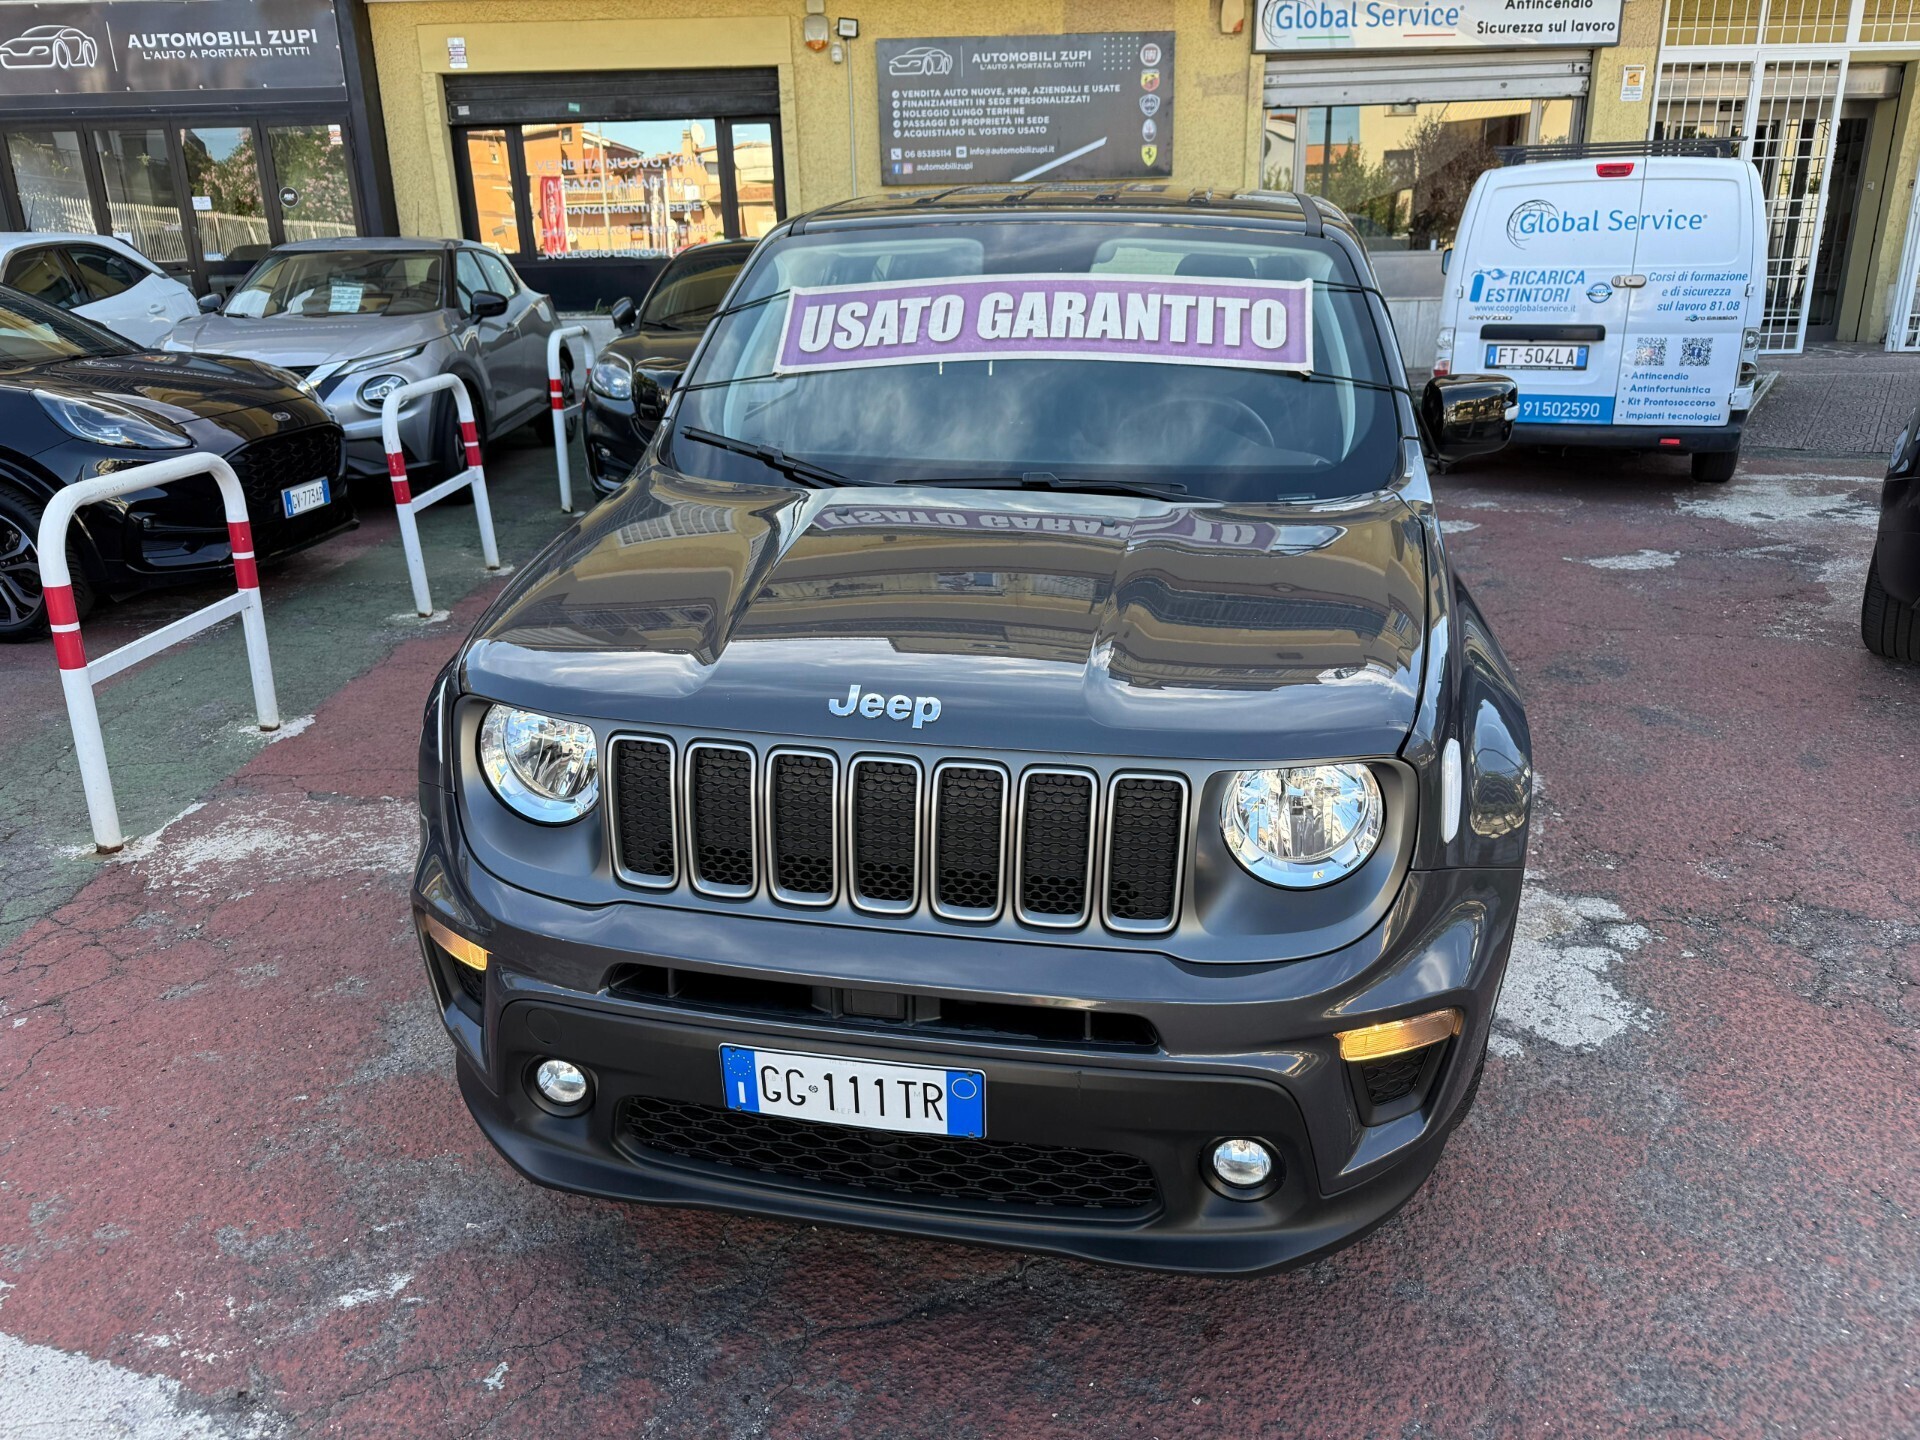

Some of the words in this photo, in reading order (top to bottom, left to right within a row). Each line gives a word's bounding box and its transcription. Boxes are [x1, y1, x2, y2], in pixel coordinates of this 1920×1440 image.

[1276, 1, 1358, 29] Global
[1366, 2, 1459, 27] Service
[1477, 21, 1543, 34] Sicurezza
[1548, 20, 1566, 32] sul
[1571, 20, 1615, 32] lavoro
[128, 31, 261, 48] AUTOMOBILI
[268, 29, 318, 44] ZUPI
[143, 50, 186, 59] L'AUTO
[202, 48, 257, 58] PORTATA
[261, 48, 272, 56] DI
[276, 47, 310, 56] TUTTI
[972, 52, 1056, 63] AUTOMOBILI
[1060, 50, 1092, 60] ZUPI
[902, 90, 940, 98] VENDITA
[944, 88, 968, 96] AUTO
[971, 88, 1004, 96] NUOVE,
[1033, 85, 1081, 94] AZIENDALI
[1084, 85, 1089, 93] E
[1092, 84, 1120, 92] USATE
[902, 99, 973, 108] FINANZIAMENTI
[976, 98, 985, 106] IN
[1014, 95, 1090, 104] PERSONALIZZATI
[902, 109, 949, 118] NOLEGGIO
[952, 108, 983, 116] LUNGO
[986, 107, 1025, 115] TERMINE
[903, 119, 946, 127] PASSAGGI
[950, 118, 959, 126] DI
[962, 116, 1012, 126] PROPRIETÀ
[1027, 116, 1049, 124] SEDE
[904, 129, 965, 138] ACQUISTIAMO
[979, 127, 1015, 135] VOSTRO
[1018, 126, 1047, 134] USATO
[669, 202, 702, 212] SEDE
[1520, 210, 1598, 234] Global
[1608, 209, 1702, 231] Service
[545, 250, 611, 260] NOLEGGIO
[614, 248, 658, 258] LUNGO
[1509, 270, 1585, 285] RICARICA
[1649, 271, 1676, 282] Corsi
[1680, 271, 1689, 281] di
[1690, 271, 1748, 281] formazione
[1486, 288, 1570, 302] ESTINTORI
[1670, 286, 1681, 296] di
[1682, 286, 1731, 296] sicurezza
[1475, 304, 1576, 313] www.coopglobalservice.it
[1657, 300, 1674, 311] sul
[1675, 301, 1706, 311] lavoro
[1709, 301, 1740, 311] 81.08
[799, 294, 964, 352] USATO
[977, 292, 1287, 349] GARANTITO
[1631, 372, 1689, 380] Antincendio
[1630, 384, 1711, 394] Antinfortunistica
[1628, 397, 1640, 405] Kit
[1644, 398, 1715, 407] Prontosoccorso
[1524, 401, 1600, 417] 91502590
[1626, 411, 1664, 420] Impianti
[1668, 413, 1720, 422] tecnologici
[829, 684, 941, 729] Jeep
